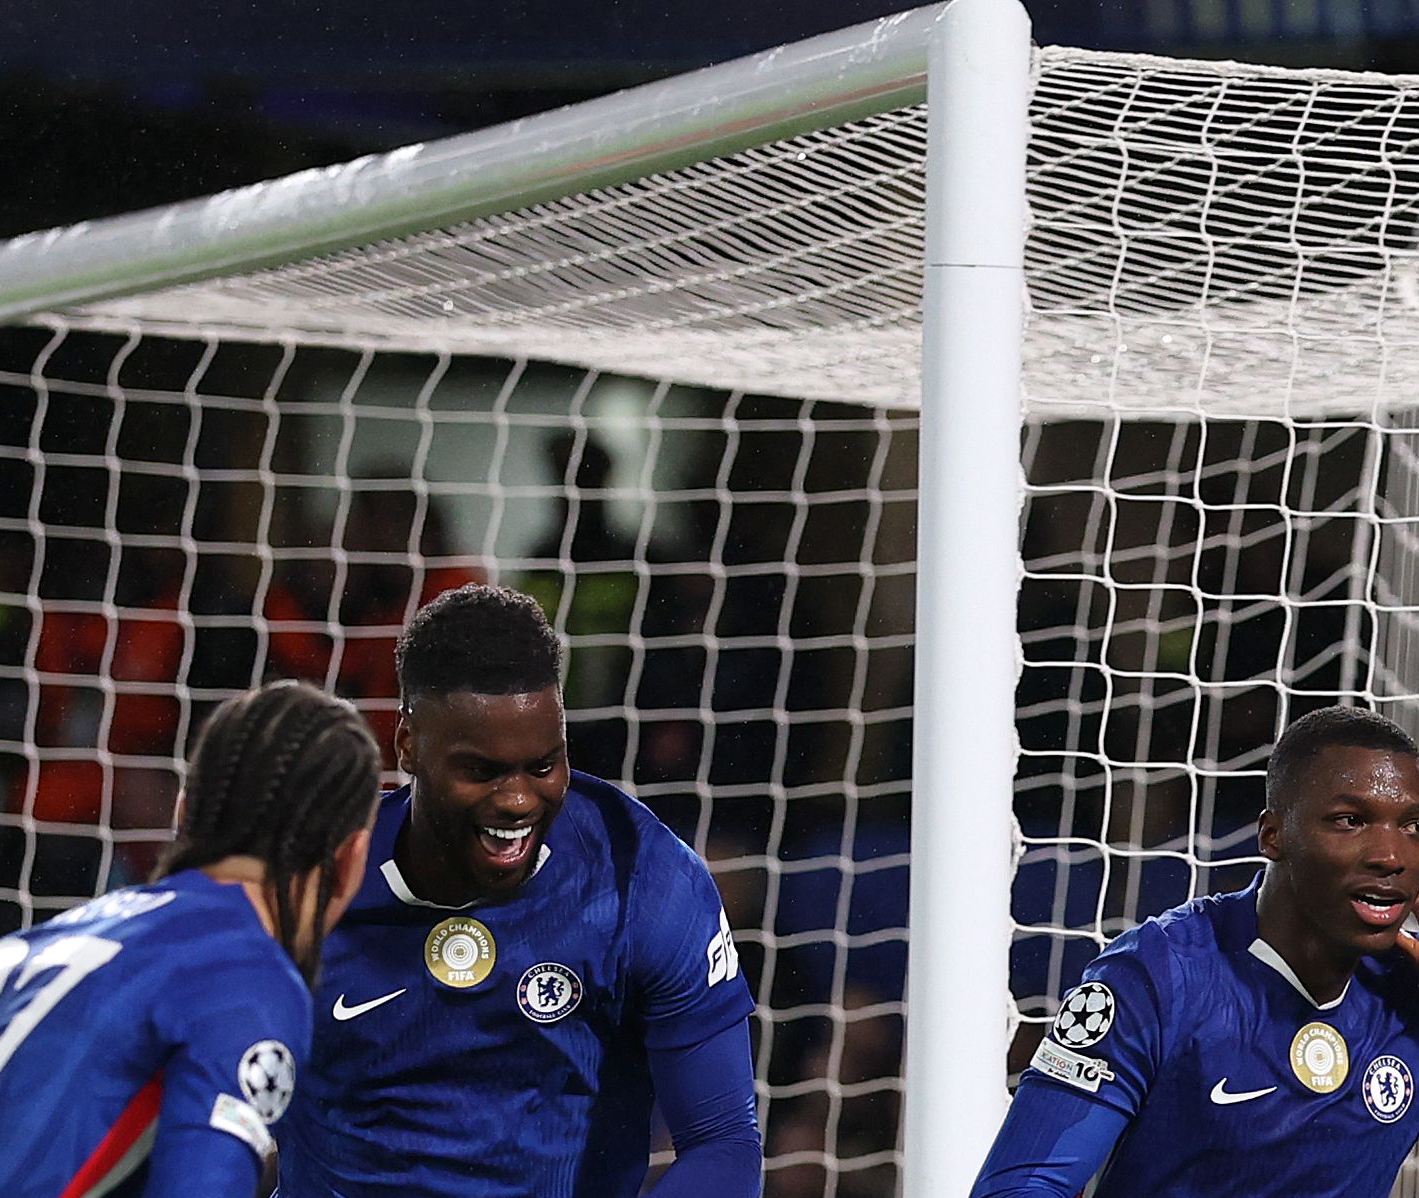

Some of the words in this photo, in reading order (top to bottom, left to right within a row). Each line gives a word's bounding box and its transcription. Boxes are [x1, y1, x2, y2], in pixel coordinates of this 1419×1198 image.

[430, 928, 448, 962] WORLD
[448, 923, 490, 960] CHAMPIONS
[447, 970, 476, 982] FIFA
[527, 964, 570, 979] CHELSEA
[1368, 1058, 1402, 1076] CHELSEA
[1310, 1075, 1335, 1087] FIFA
